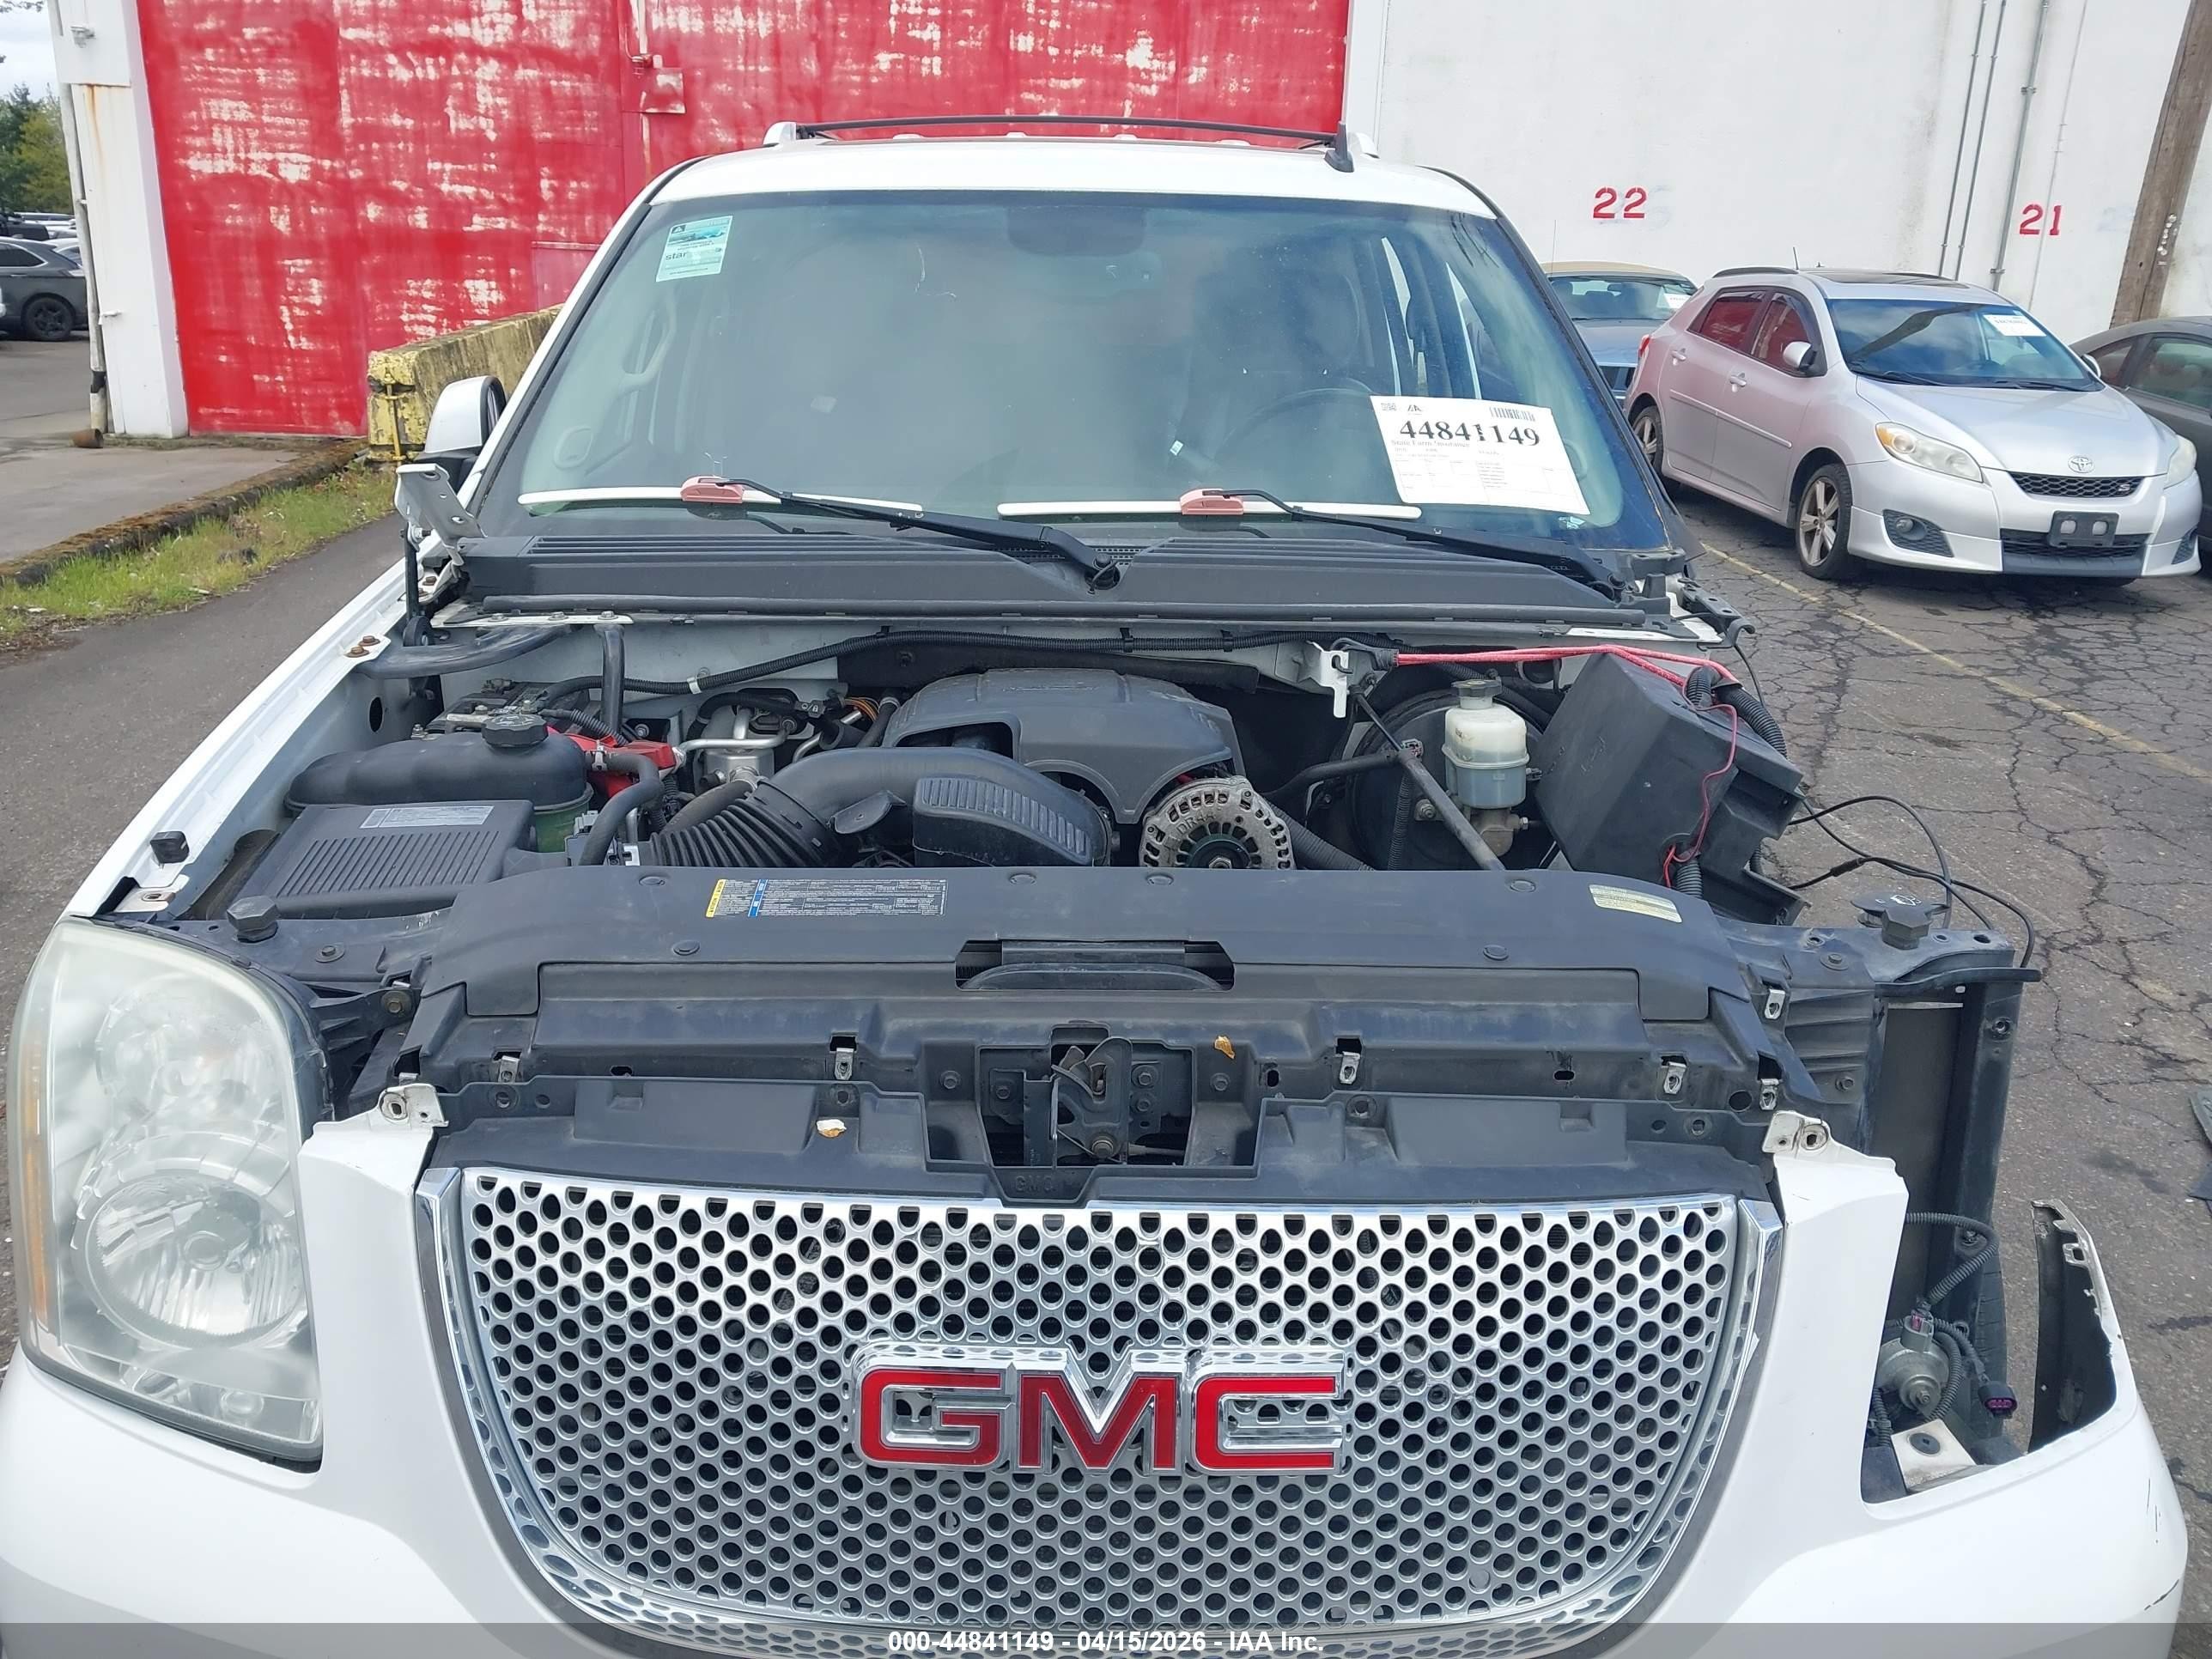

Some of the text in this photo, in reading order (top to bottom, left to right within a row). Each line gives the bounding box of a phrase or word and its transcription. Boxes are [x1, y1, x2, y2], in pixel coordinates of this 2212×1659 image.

[1593, 187, 1647, 219] 22
[2019, 204, 2062, 236] 21
[1400, 420, 1540, 446] 44841149
[854, 1348, 1344, 1475] GMC
